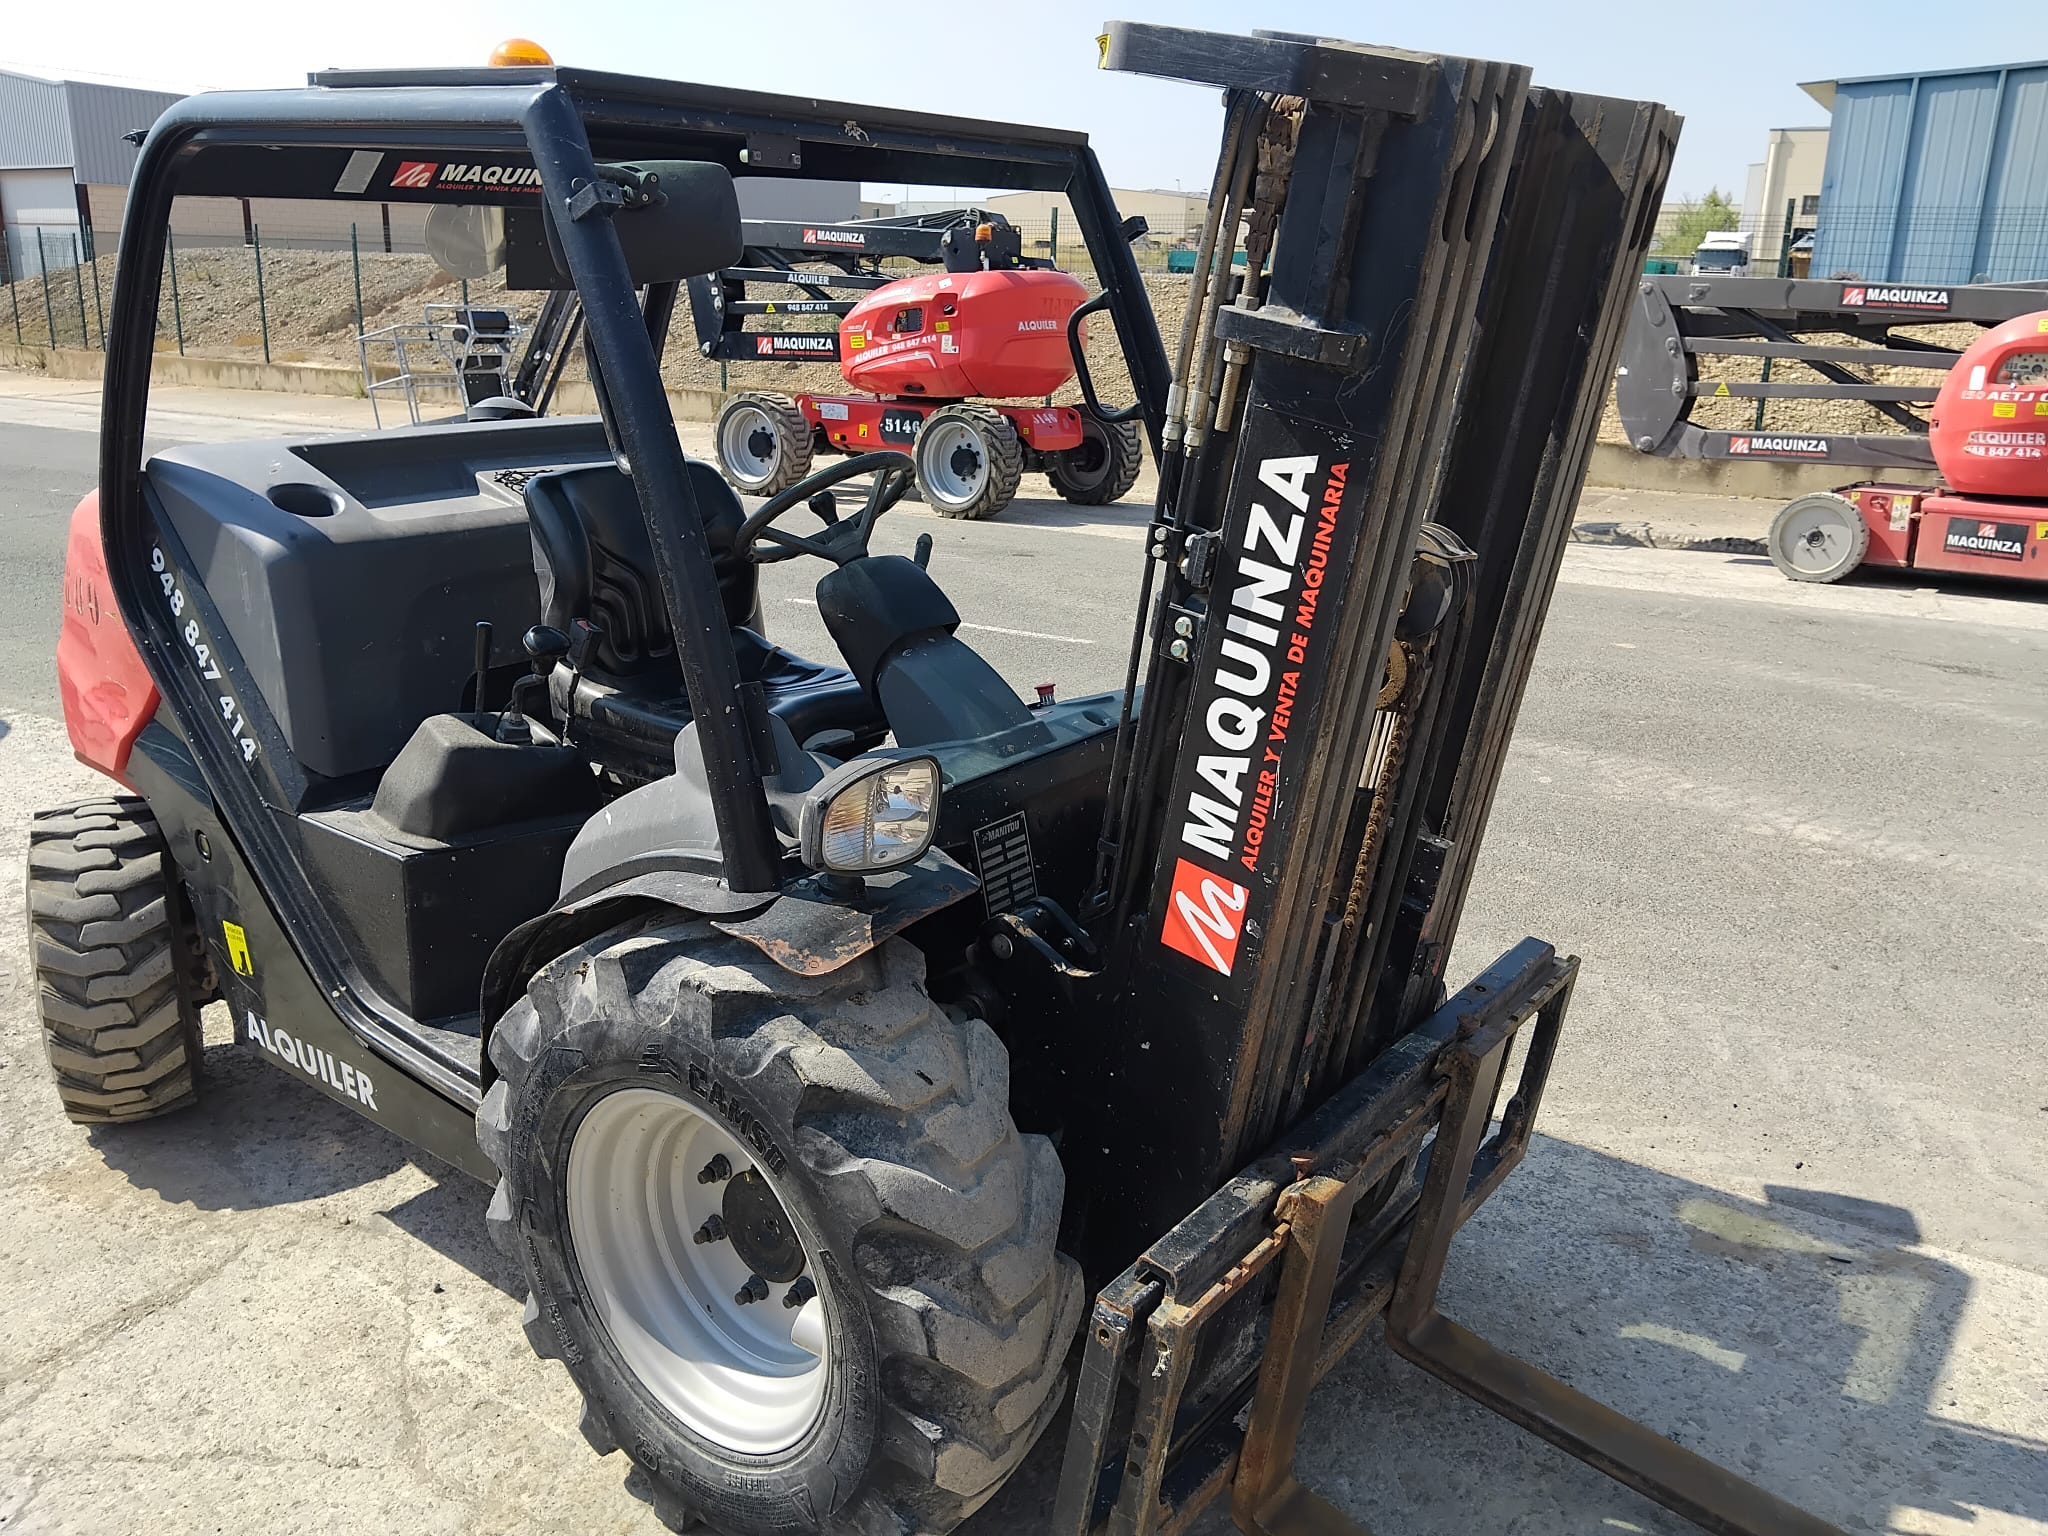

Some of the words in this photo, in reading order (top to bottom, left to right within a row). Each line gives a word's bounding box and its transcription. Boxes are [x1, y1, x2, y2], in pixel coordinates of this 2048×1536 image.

[436, 183, 473, 191] ALQUILER
[817, 230, 865, 244] MAQUINZA
[787, 273, 830, 285] ALQUILER
[1866, 288, 1949, 304] MAQUINZA
[787, 303, 800, 311] 948
[801, 303, 814, 311] 847
[815, 303, 828, 311] 414
[1018, 320, 1057, 331] ALQUILER
[773, 337, 834, 350] MAQUINZA
[855, 345, 889, 363] ALQUILER
[921, 334, 937, 344] 414
[1987, 391, 2035, 401] AETJ
[885, 418, 921, 434] 5146
[1751, 437, 1828, 451] MAQUINZA
[1988, 446, 2012, 457] 847
[2015, 446, 2041, 457] 414
[1298, 463, 1350, 631] MAQUINARIA
[1946, 534, 2022, 554] MAQUINZA
[151, 547, 185, 617] 948
[184, 619, 222, 681] 847
[219, 696, 256, 762] 414
[1181, 455, 1319, 861] MAQUINZA
[1287, 634, 1309, 665] DE
[1269, 672, 1300, 742] VENTA
[1264, 746, 1282, 764] Y
[1240, 771, 1276, 871] ALQUILER
[988, 820, 1020, 841] MANITOU
[247, 1010, 379, 1112] ALQUILER
